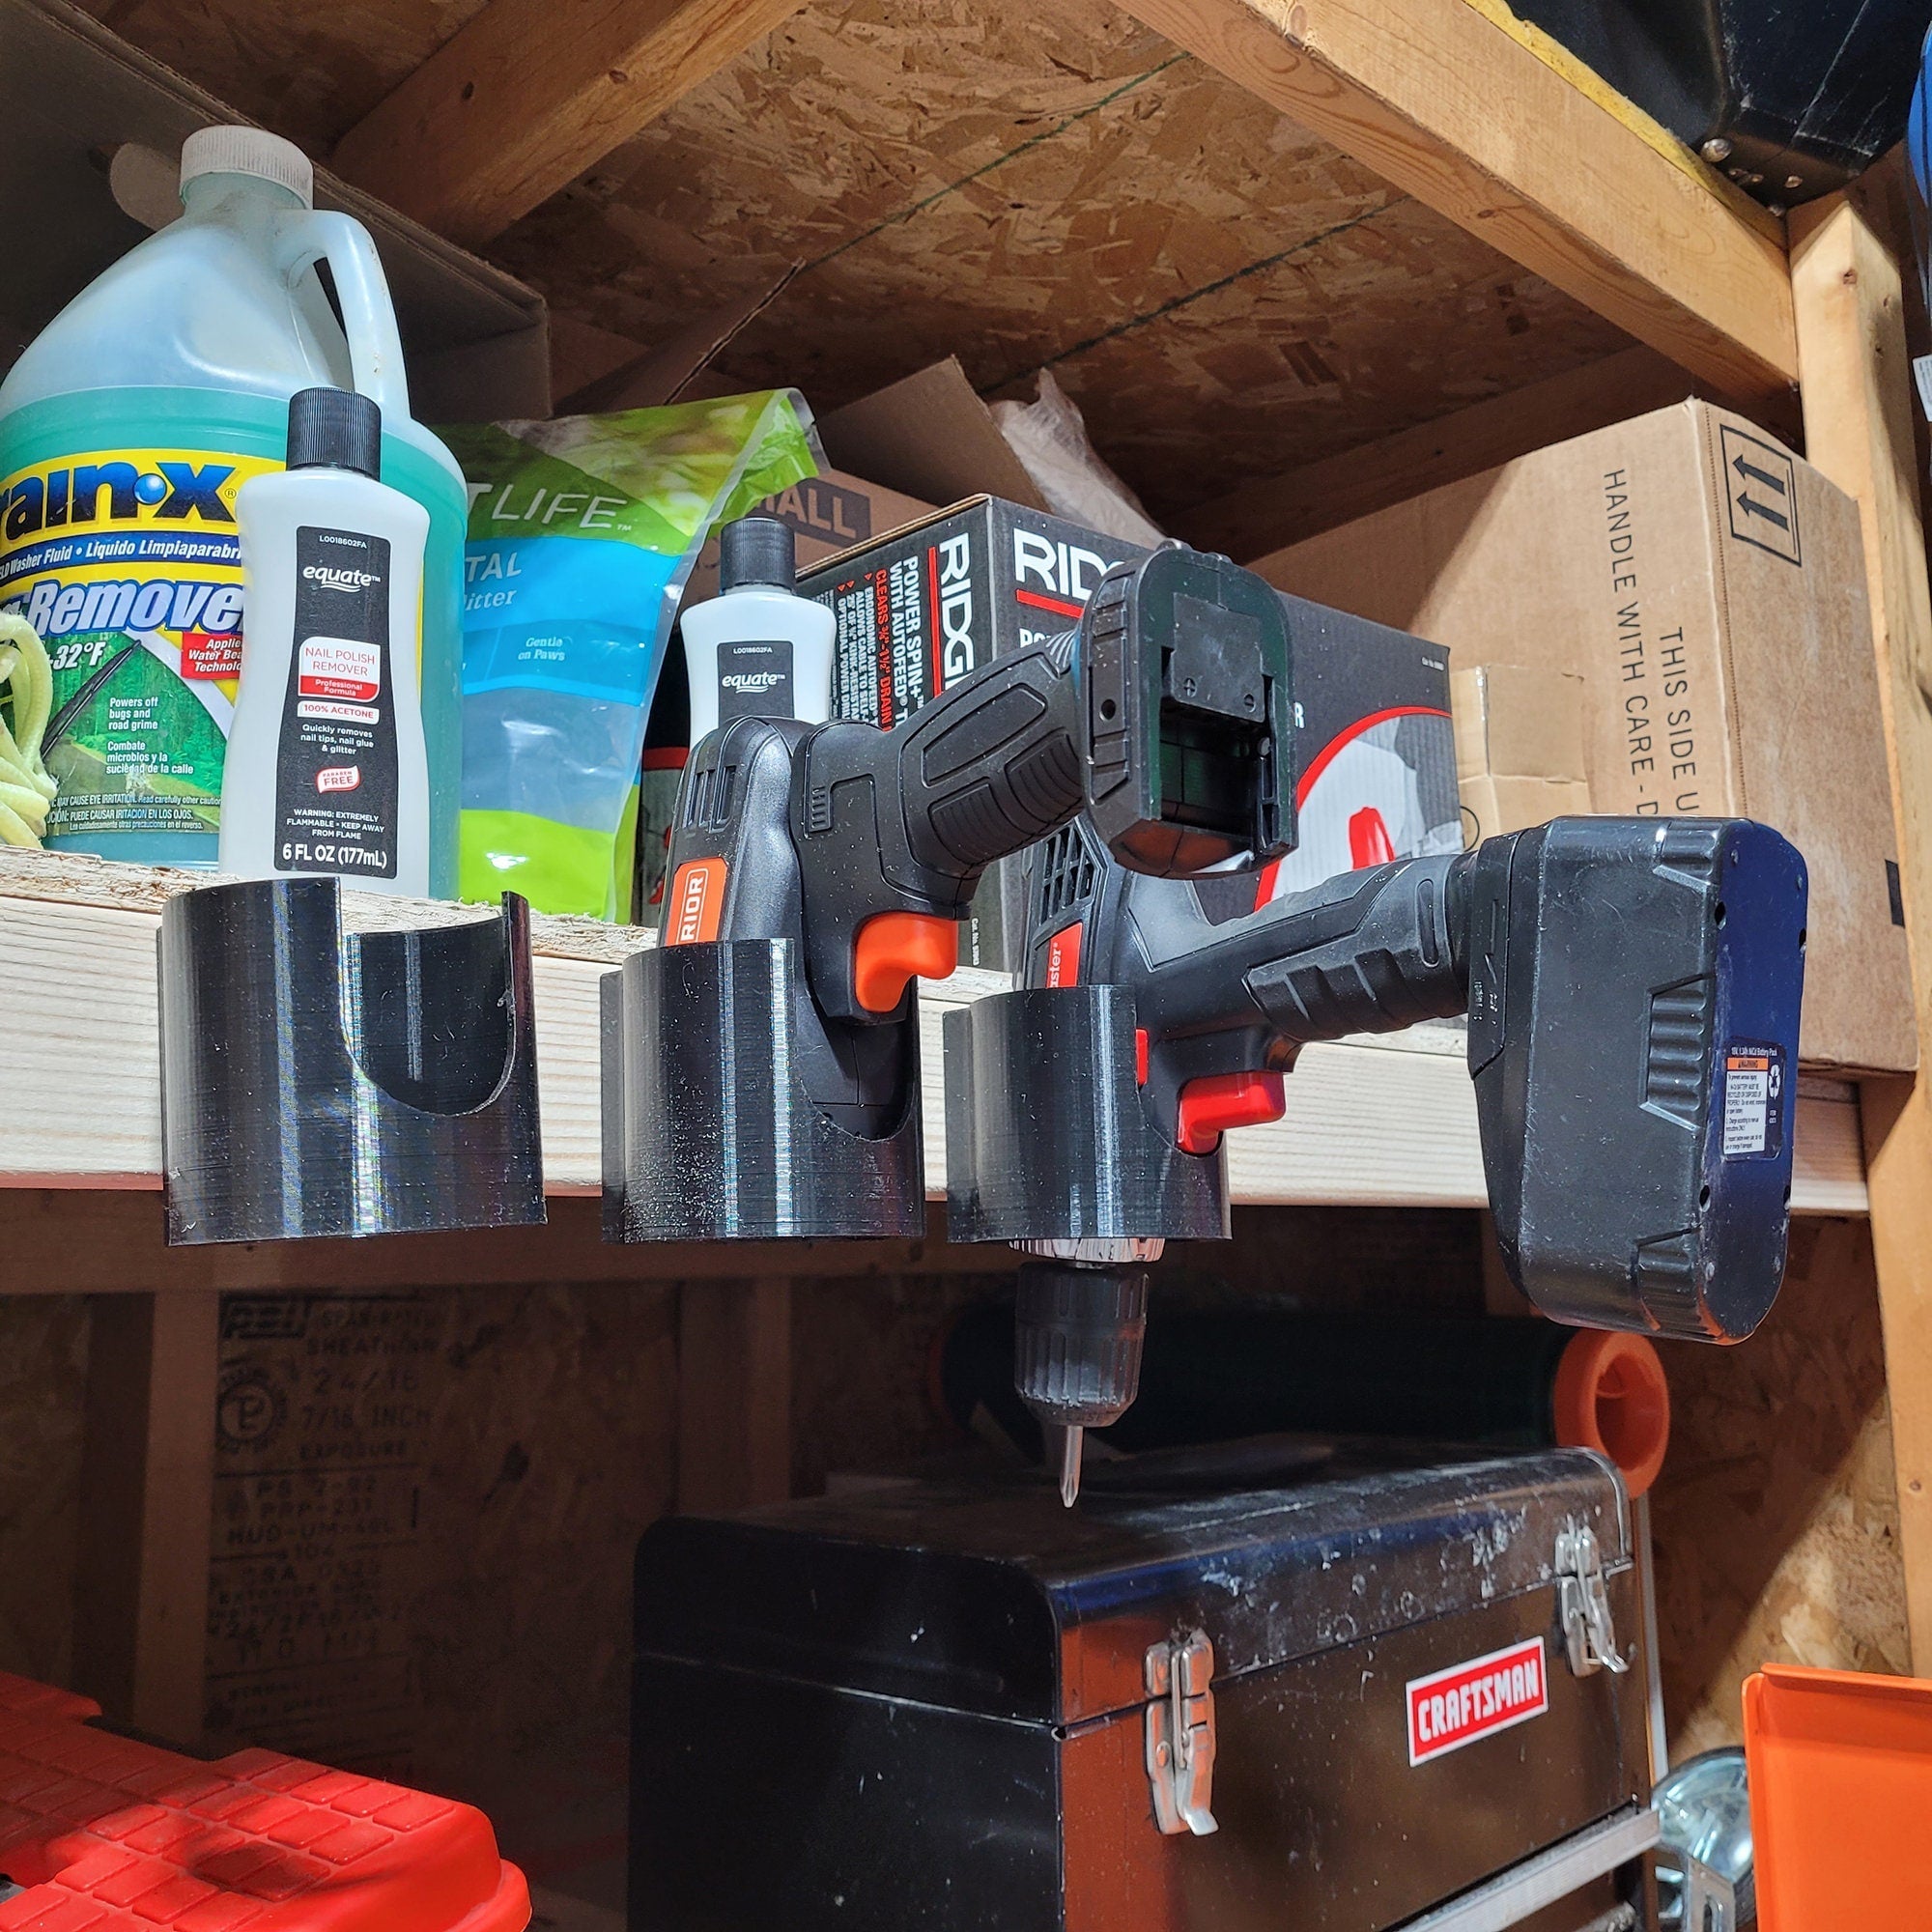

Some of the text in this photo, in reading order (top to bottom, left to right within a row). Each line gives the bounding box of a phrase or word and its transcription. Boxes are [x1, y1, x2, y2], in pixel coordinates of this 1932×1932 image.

[1604, 469, 1637, 593] HANDLE
[10, 554, 43, 575] Washer
[43, 545, 73, 564] Fluid
[1012, 527, 1125, 601] RID
[889, 560, 904, 611] WITH
[875, 568, 890, 626] CLEARS
[902, 555, 922, 634] POWER
[26, 580, 244, 637] Remove
[855, 590, 867, 638] ALLOWS
[837, 597, 848, 654] OPTIONAL
[847, 611, 857, 626] OF
[864, 585, 876, 654] ERGONOMIC
[525, 637, 563, 648] Gentle
[1616, 601, 1646, 683] WITH
[188, 649, 221, 661] Water
[305, 647, 376, 665] NAIL POLISH
[518, 649, 565, 662] on Paws
[857, 638, 867, 673] CABLE
[1660, 626, 1689, 697] THIS
[312, 661, 368, 676] REMOVER
[838, 654, 850, 694] POWER
[315, 678, 363, 691] Professional
[859, 672, 867, 690] TO
[324, 687, 356, 696] Formula
[109, 696, 158, 707] Powers off
[879, 676, 893, 723] DRAIN
[109, 709, 151, 720] bugs and
[304, 704, 374, 719] 100% ACETONE
[108, 721, 158, 731] road grime
[302, 724, 373, 738] Quickly removes
[318, 735, 337, 744] tips,
[355, 739, 374, 748] glue
[1625, 695, 1655, 777] CARE
[107, 741, 146, 751] Combate
[330, 745, 356, 754] glitter
[1667, 709, 1697, 781] SIDE
[106, 753, 168, 764] microbios y la
[106, 764, 194, 775] suciedad de la calle
[324, 776, 354, 786] FREE
[70, 795, 89, 807] CAUSE
[89, 794, 101, 806] EYE
[155, 796, 182, 805] carefully
[182, 796, 199, 805] other
[70, 810, 90, 821] PUEDE
[90, 809, 115, 820] CAUSAR
[148, 810, 157, 819] EN
[158, 810, 173, 819] LOS
[173, 809, 194, 820] OJOS.
[294, 809, 380, 822] WARNING: EXTREMELY
[286, 818, 334, 827] FLAMMABLE
[361, 824, 385, 833] AWAY
[311, 829, 334, 838] FROM
[282, 842, 387, 869] 6 FL OZ (177mL)
[1418, 1658, 1539, 1743] CRAFTSMAN
